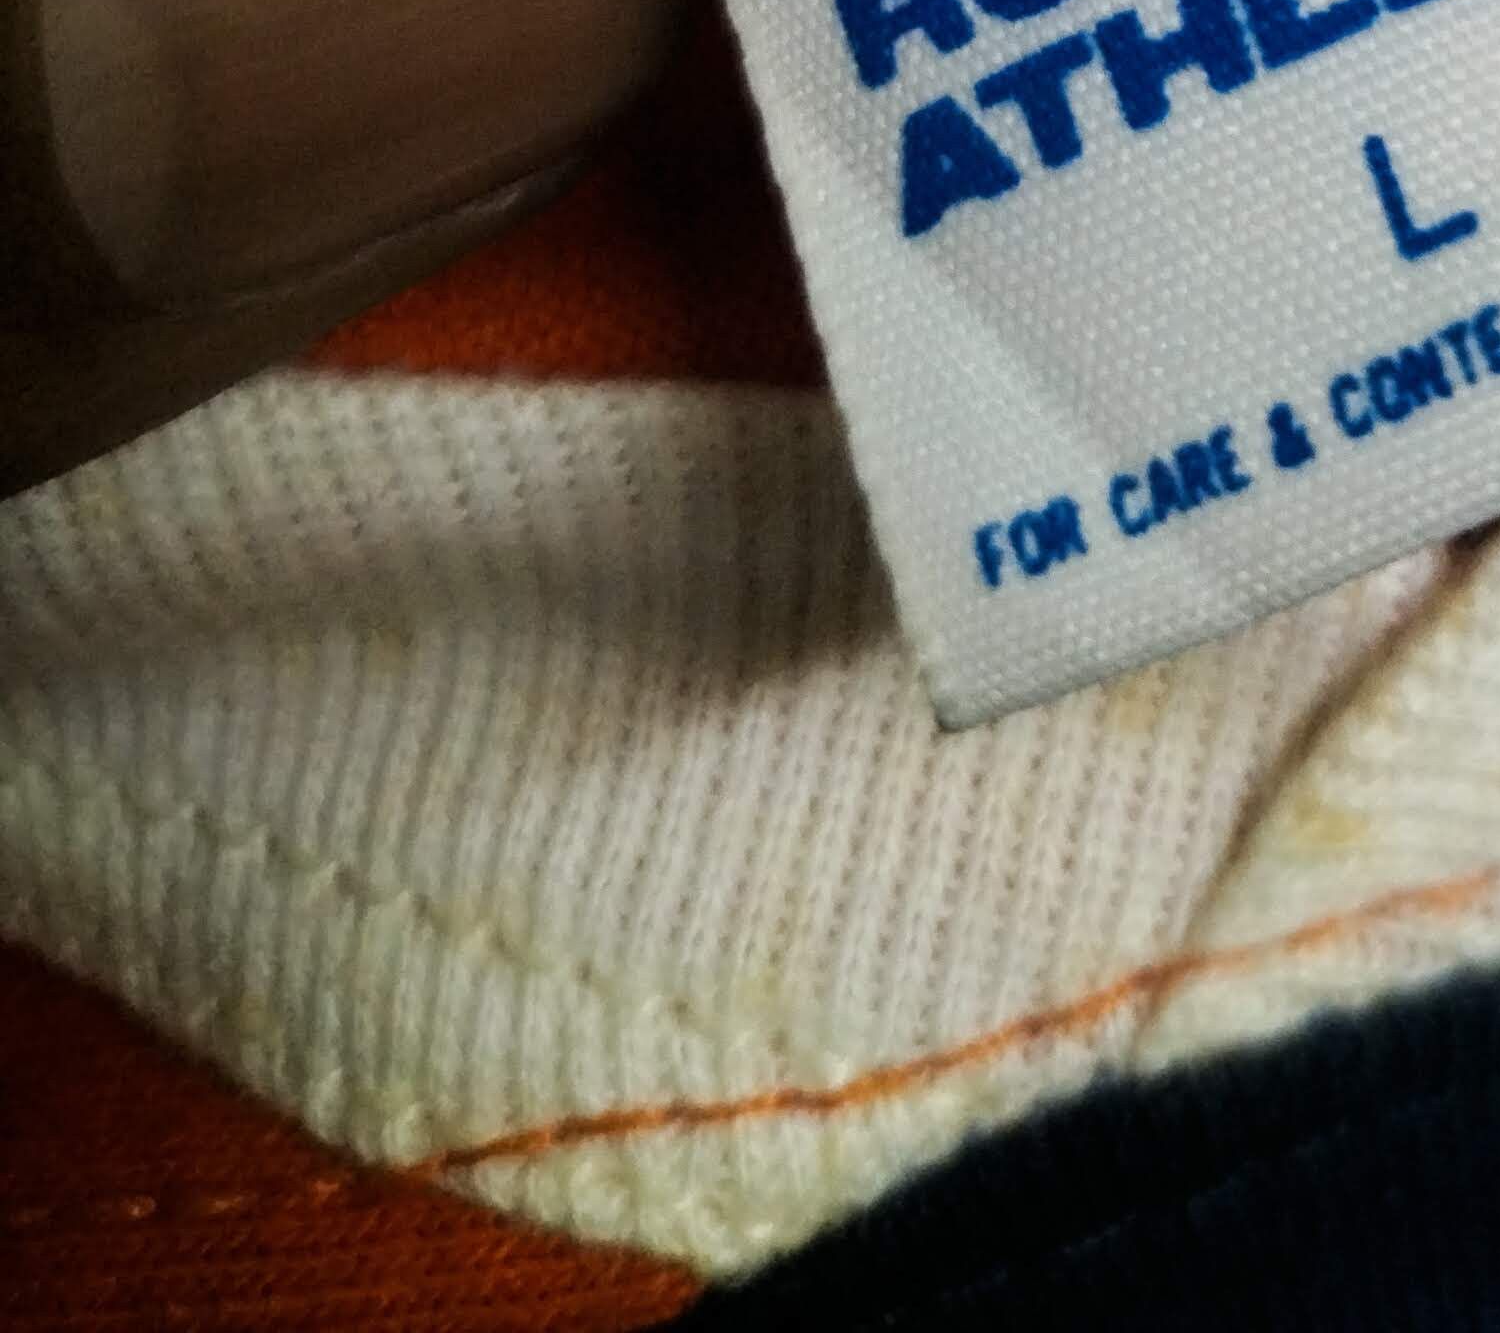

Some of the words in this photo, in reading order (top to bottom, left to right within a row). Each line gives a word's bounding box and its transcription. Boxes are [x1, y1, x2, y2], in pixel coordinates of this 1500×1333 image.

[1363, 135, 1479, 262] L
[974, 495, 1089, 589] FOR
[1108, 425, 1252, 539] CARE
[1266, 402, 1317, 471] &
